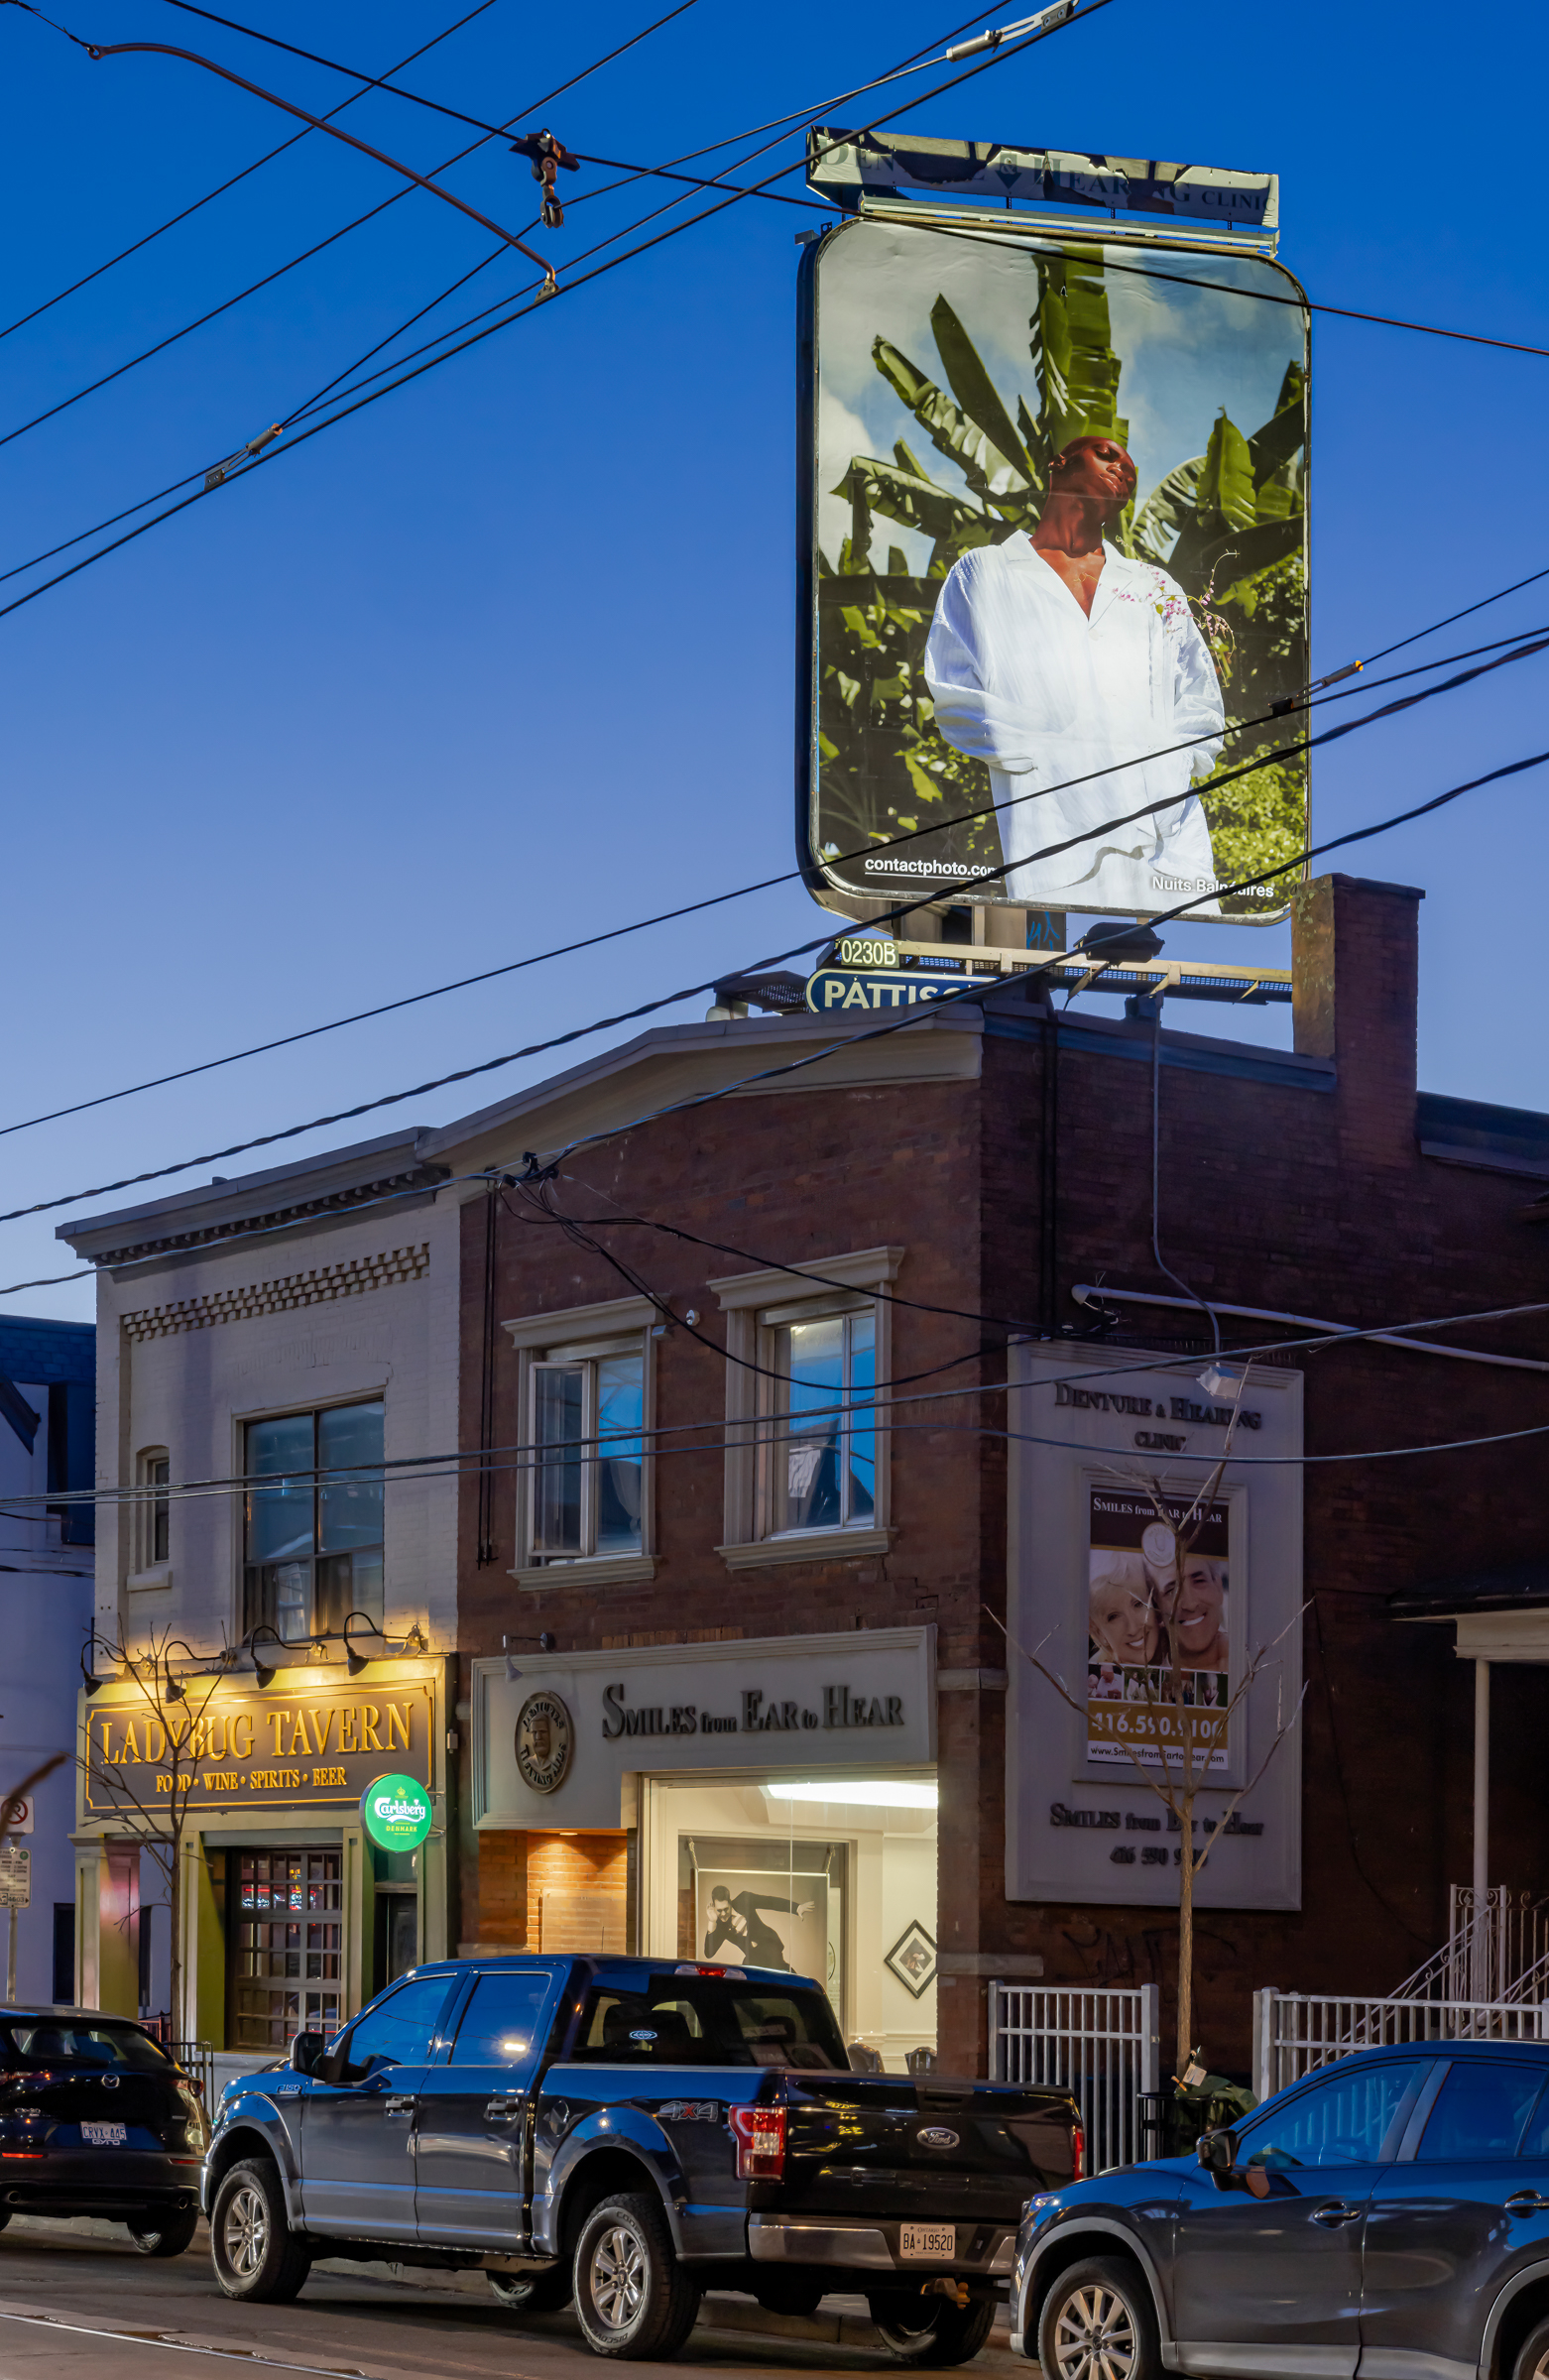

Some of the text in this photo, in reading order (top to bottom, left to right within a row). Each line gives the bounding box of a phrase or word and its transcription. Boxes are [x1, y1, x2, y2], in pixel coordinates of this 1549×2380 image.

[1033, 157, 1190, 202] HEARNG
[1201, 189, 1276, 211] CLINIC
[1152, 876, 1192, 892] Nuits
[841, 939, 896, 965] 0230B
[1054, 1382, 1152, 1415] DENTURE
[1155, 1403, 1166, 1418] &
[1134, 1431, 1187, 1451] CLINIC
[1093, 1496, 1132, 1513] SMILES
[1134, 1505, 1155, 1516] from
[1193, 1507, 1223, 1523] HAR
[602, 1683, 905, 1738] SMILES from EAR to HEAR
[101, 1702, 414, 1765] LADYBUG TAVERN
[202, 1772, 239, 1791] WINE
[250, 1768, 300, 1790] SPIRITS
[312, 1766, 347, 1787] BEER
[374, 1797, 425, 1821] Carlsberg
[1050, 1803, 1122, 1828] SMILES
[82, 2126, 105, 2139] CRVX
[903, 2232, 953, 2251] BA 19520
